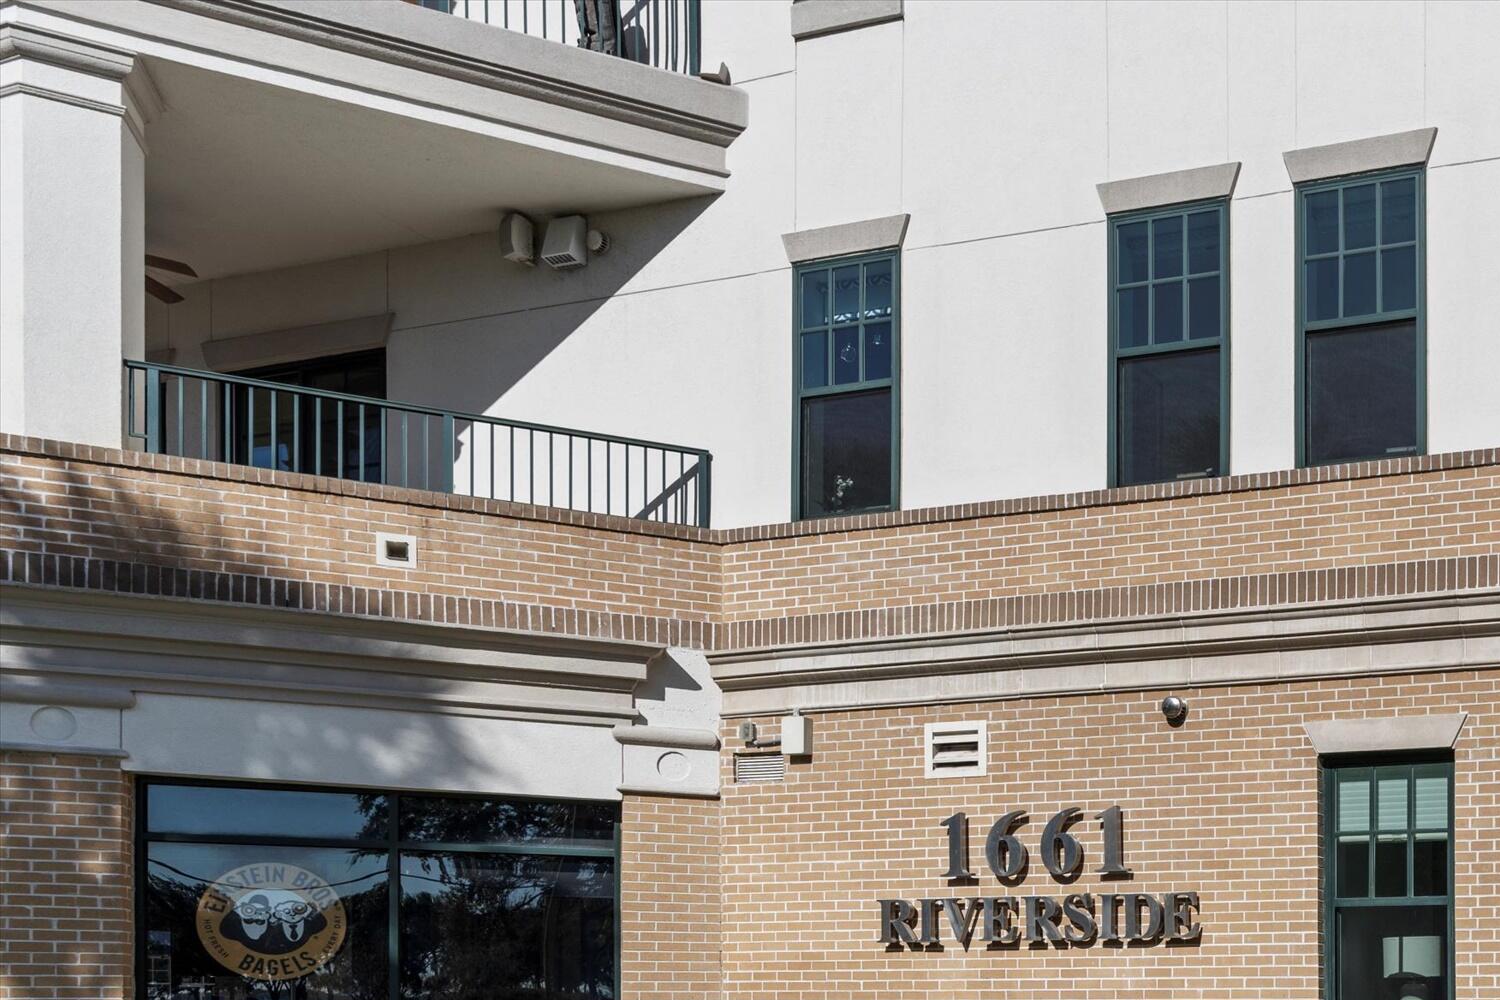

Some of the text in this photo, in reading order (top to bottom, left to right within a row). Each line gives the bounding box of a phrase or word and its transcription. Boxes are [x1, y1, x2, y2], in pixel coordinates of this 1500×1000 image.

[940, 806, 1132, 882] 1661
[203, 919, 229, 959] HOT FRESH
[877, 892, 1203, 950] RIVERSIDE
[238, 951, 317, 976] BAGELS
